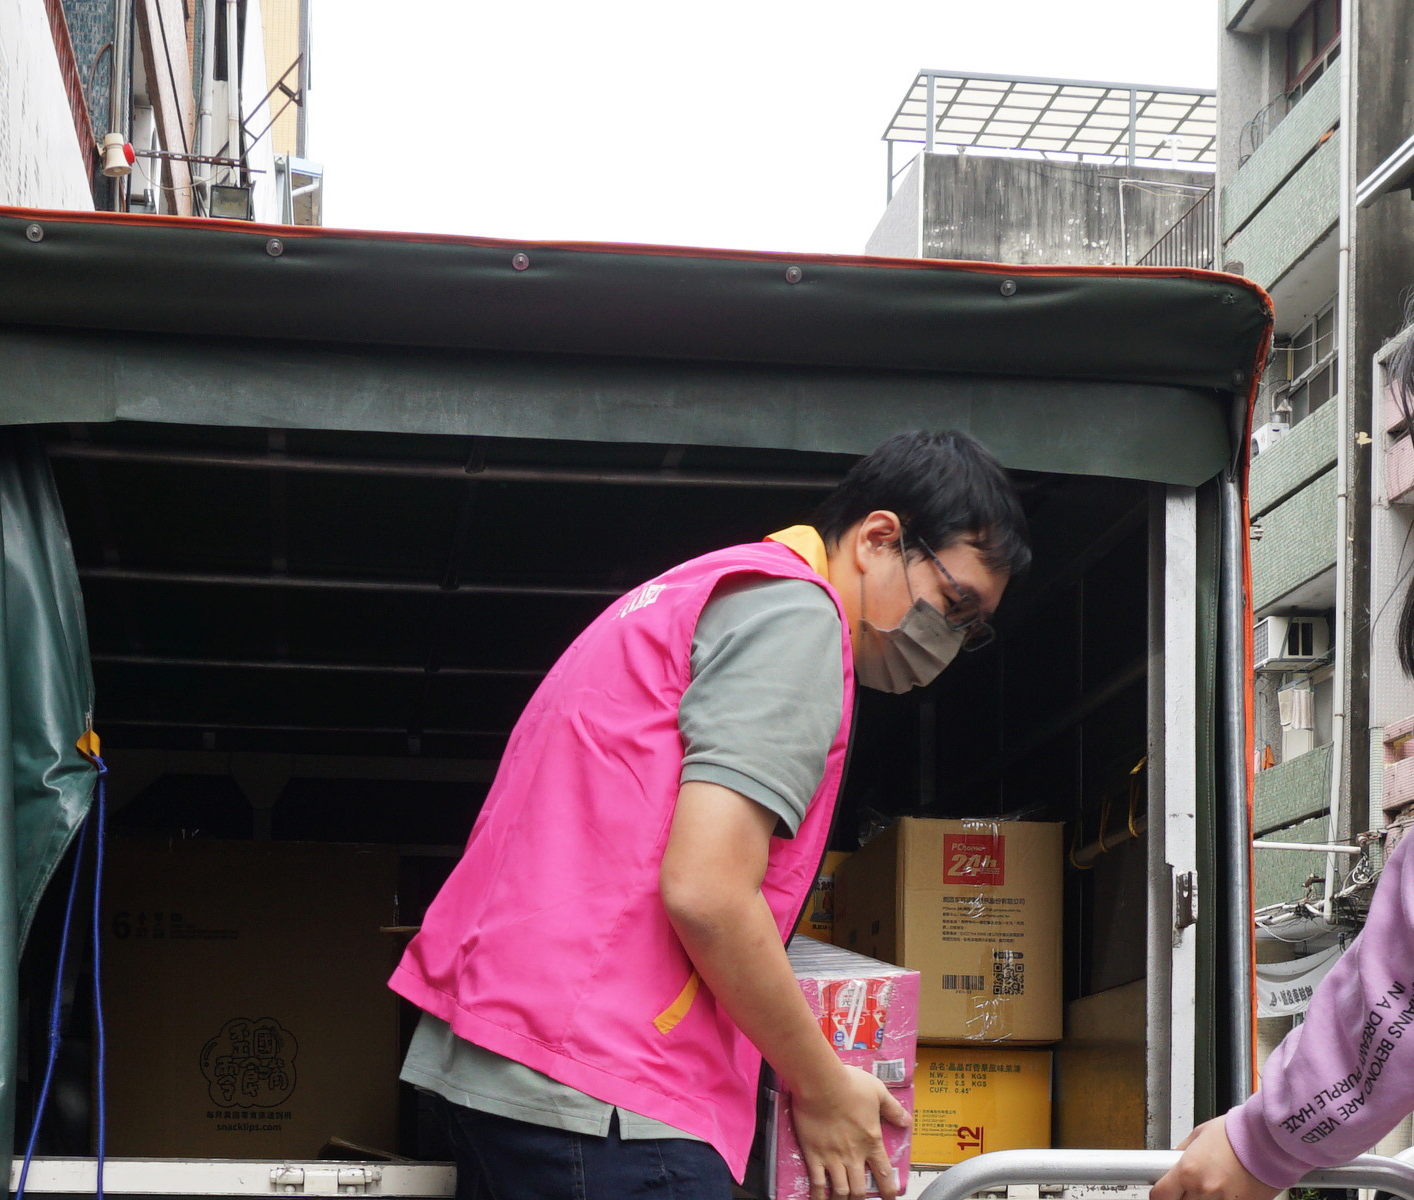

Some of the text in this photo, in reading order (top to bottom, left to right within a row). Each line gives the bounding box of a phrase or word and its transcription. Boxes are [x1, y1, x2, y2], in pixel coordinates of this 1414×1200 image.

[948, 853, 997, 876] 24h
[1376, 996, 1392, 1009] A
[1388, 981, 1407, 1000] IN
[1357, 1011, 1384, 1068] DREAMY
[1362, 1038, 1396, 1095] BEYOND
[1314, 1066, 1363, 1107] PURPLE
[1337, 1093, 1365, 1121] ARE
[957, 1126, 980, 1151] 12
[1301, 1116, 1341, 1144] VEILED
